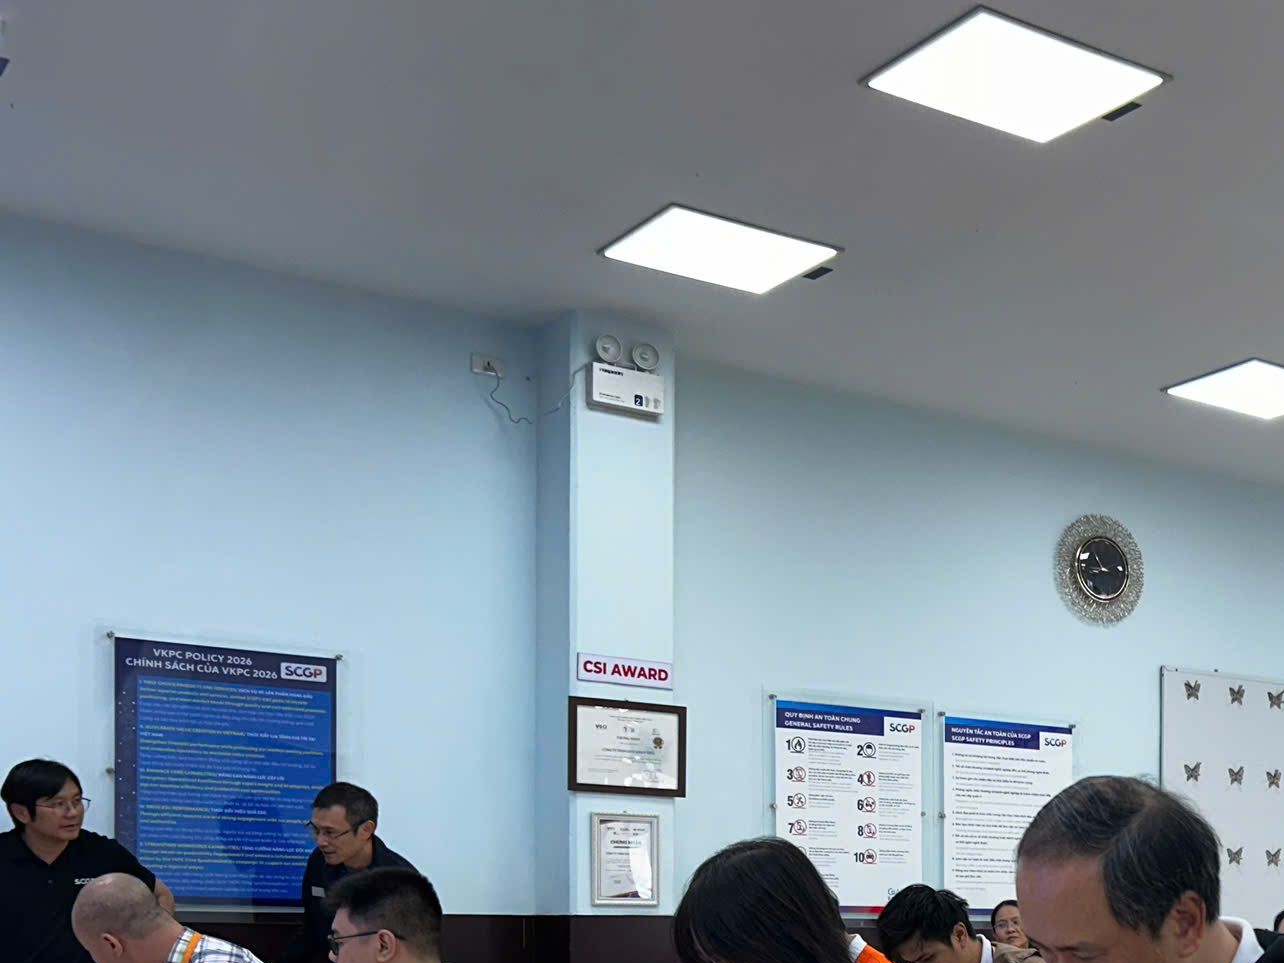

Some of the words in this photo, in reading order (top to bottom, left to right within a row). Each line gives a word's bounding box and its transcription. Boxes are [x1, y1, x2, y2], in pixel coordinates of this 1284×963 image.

[153, 648, 183, 659] VKPC
[185, 651, 225, 664] POLICY
[226, 655, 253, 666] 2026
[125, 657, 162, 669] CHÍNH
[164, 660, 194, 672] SÁCH
[196, 662, 219, 674] CỦA
[222, 666, 251, 677] VKPC
[252, 669, 278, 679] 2026
[284, 665, 323, 679] SCGP
[583, 660, 607, 675] CSI
[611, 664, 669, 682] AWARD
[784, 720, 812, 729] GENERAL
[812, 722, 834, 730] SAFETY
[834, 724, 854, 732] RULES
[889, 722, 916, 734] SCGP
[785, 739, 791, 751] 1
[966, 736, 986, 744] SAFETY
[986, 738, 1015, 747] PRINCIPLES
[1044, 737, 1067, 748] SCGP
[856, 744, 863, 757] 2
[786, 768, 794, 781] 3
[857, 773, 864, 785] 4
[787, 795, 794, 807] 5
[857, 799, 864, 811] 6
[788, 822, 795, 834] 7
[857, 825, 864, 837] 8
[854, 852, 865, 863] 10
